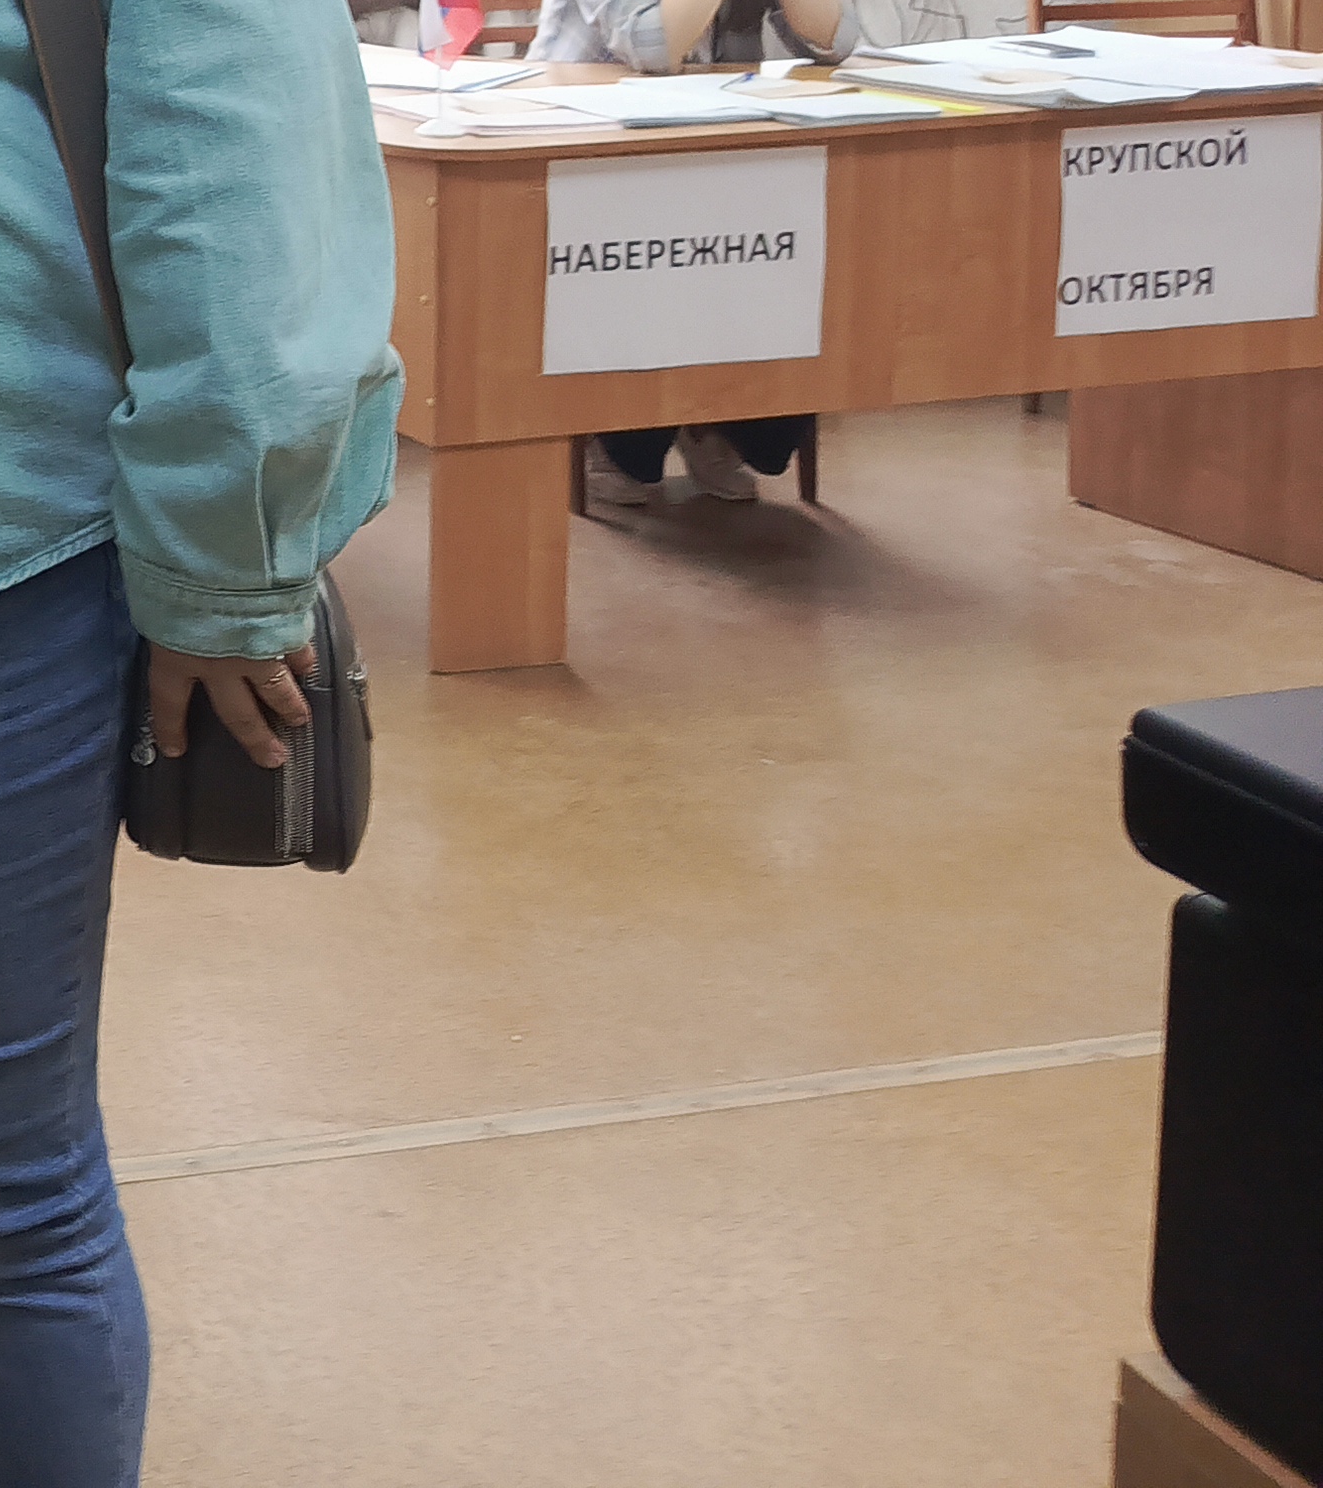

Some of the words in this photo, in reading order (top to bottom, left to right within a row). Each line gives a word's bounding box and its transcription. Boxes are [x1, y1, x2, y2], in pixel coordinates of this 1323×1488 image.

[1061, 128, 1249, 178] КРУПСКОЙ
[548, 230, 797, 276] НАБЕРЕЖНАЯ
[1058, 266, 1216, 306] ОКТЯБРЯ
